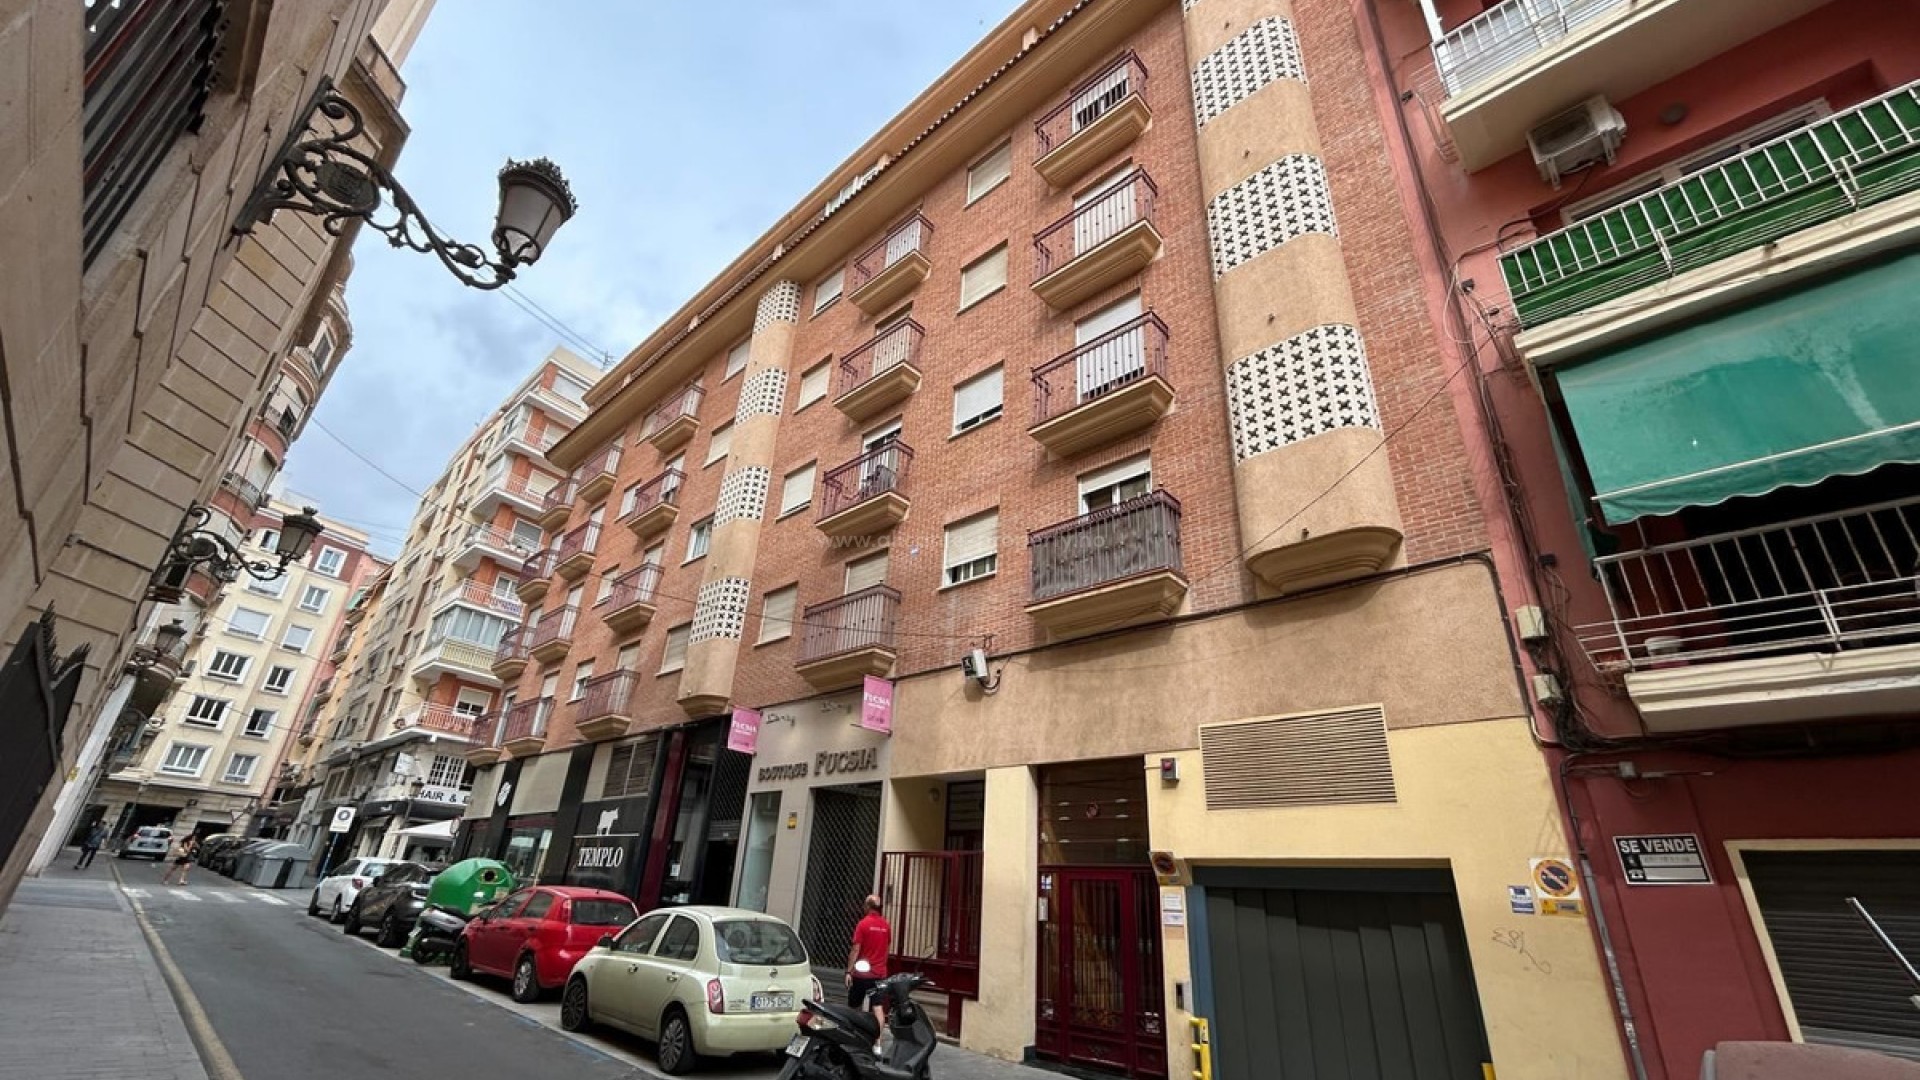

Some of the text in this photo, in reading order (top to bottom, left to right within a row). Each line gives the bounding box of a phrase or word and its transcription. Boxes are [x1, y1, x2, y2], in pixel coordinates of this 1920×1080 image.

[814, 747, 878, 775] FUCSIA
[1619, 838, 1697, 853] SE VENDE
[577, 847, 624, 868] TEMPLO
